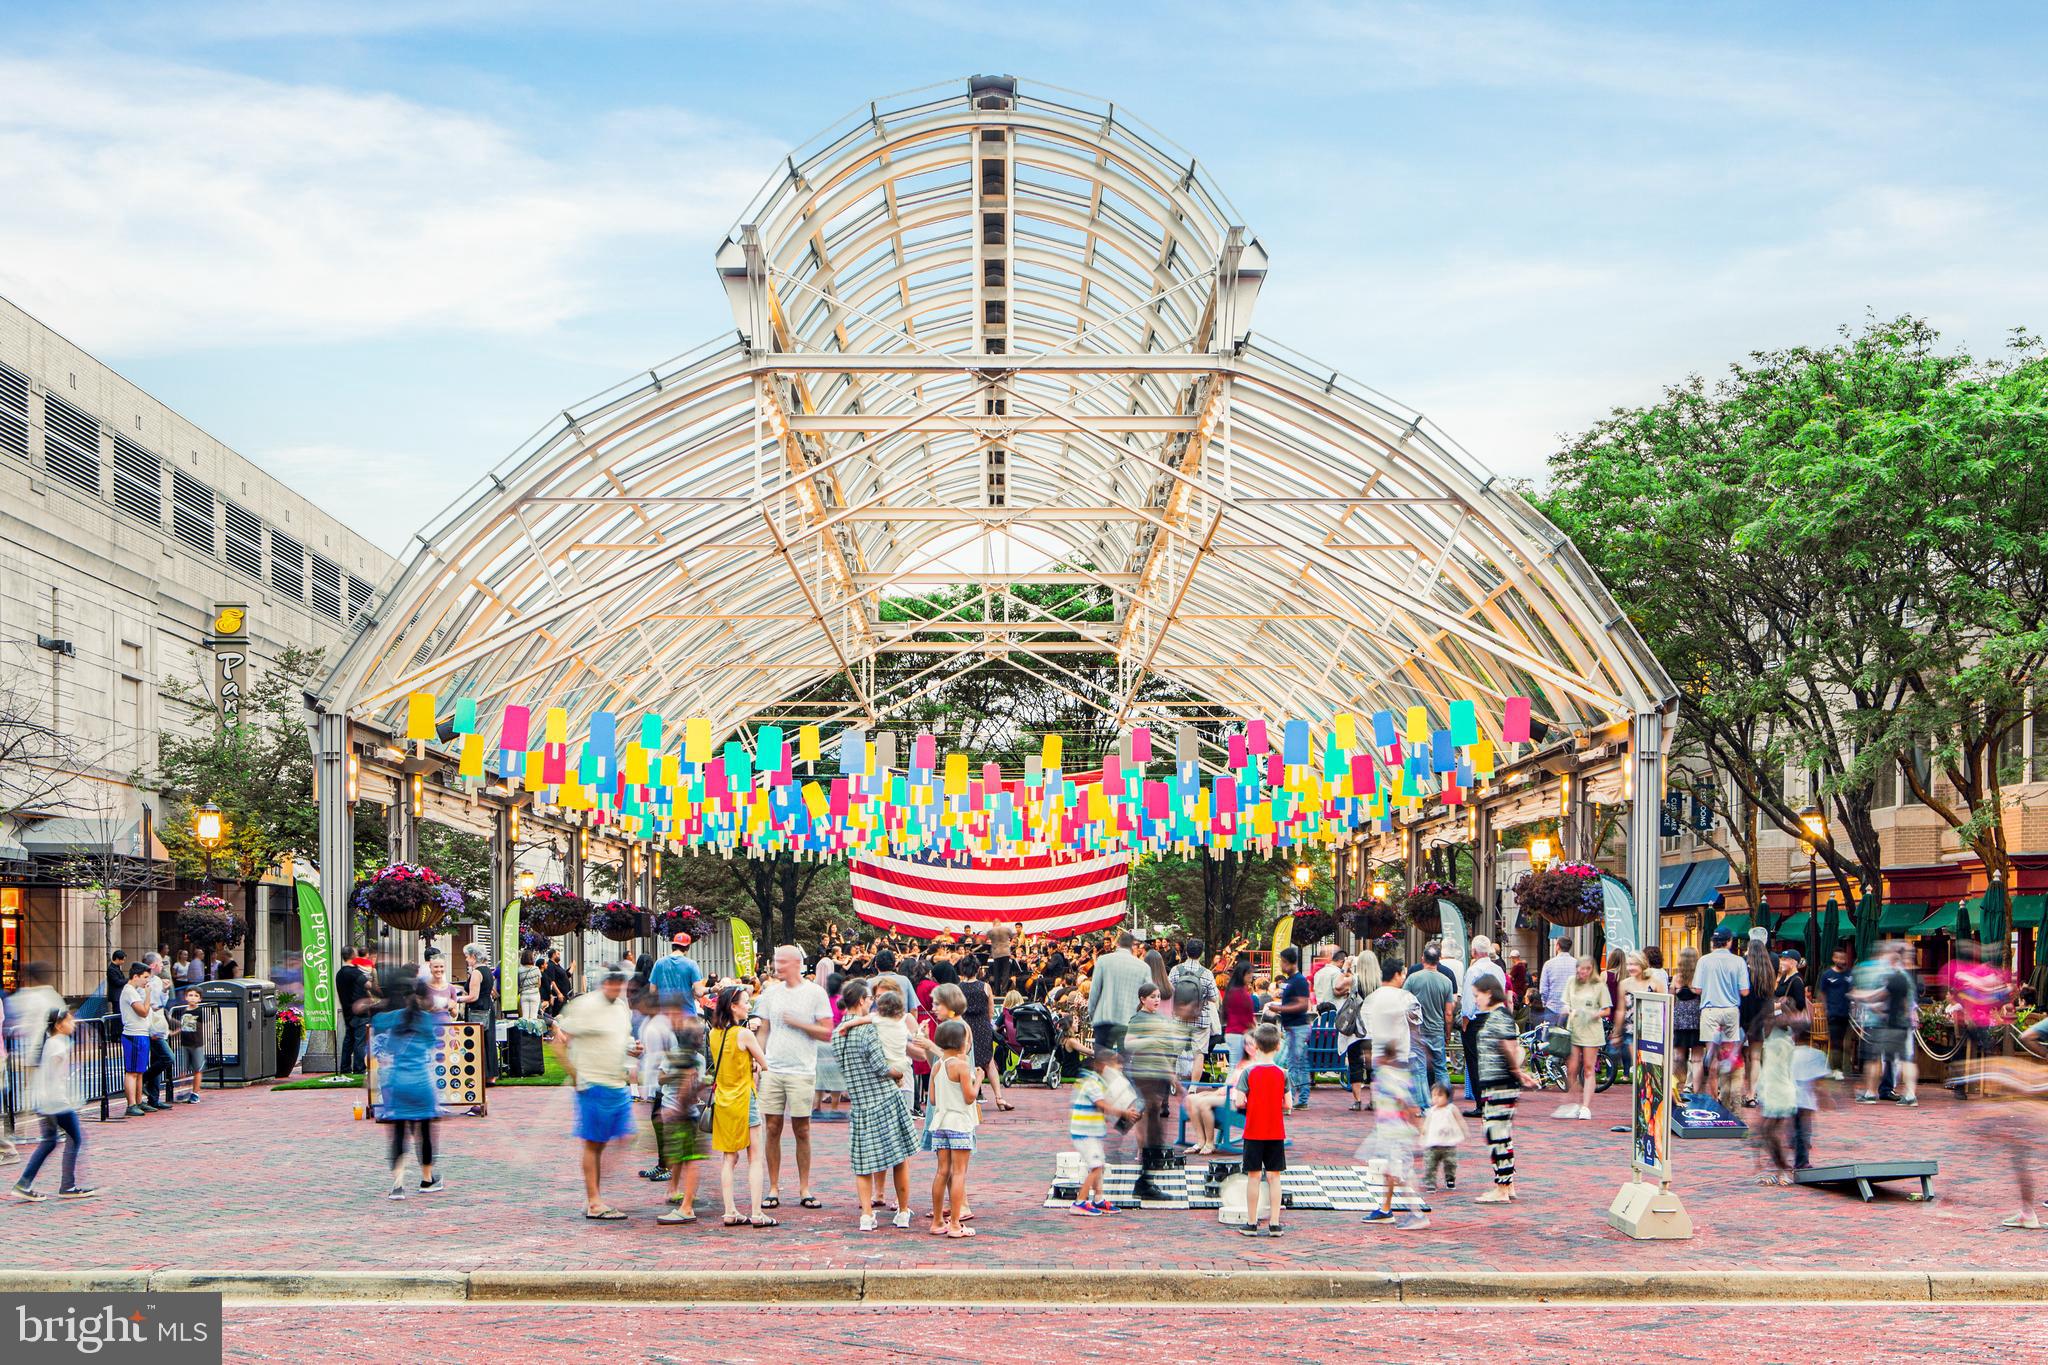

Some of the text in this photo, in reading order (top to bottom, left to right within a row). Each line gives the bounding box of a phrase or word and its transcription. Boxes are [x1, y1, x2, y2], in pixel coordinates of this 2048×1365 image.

[216, 651, 246, 748] Pane
[1663, 802, 1671, 826] SEVICE
[311, 912, 329, 1003] OneWorld
